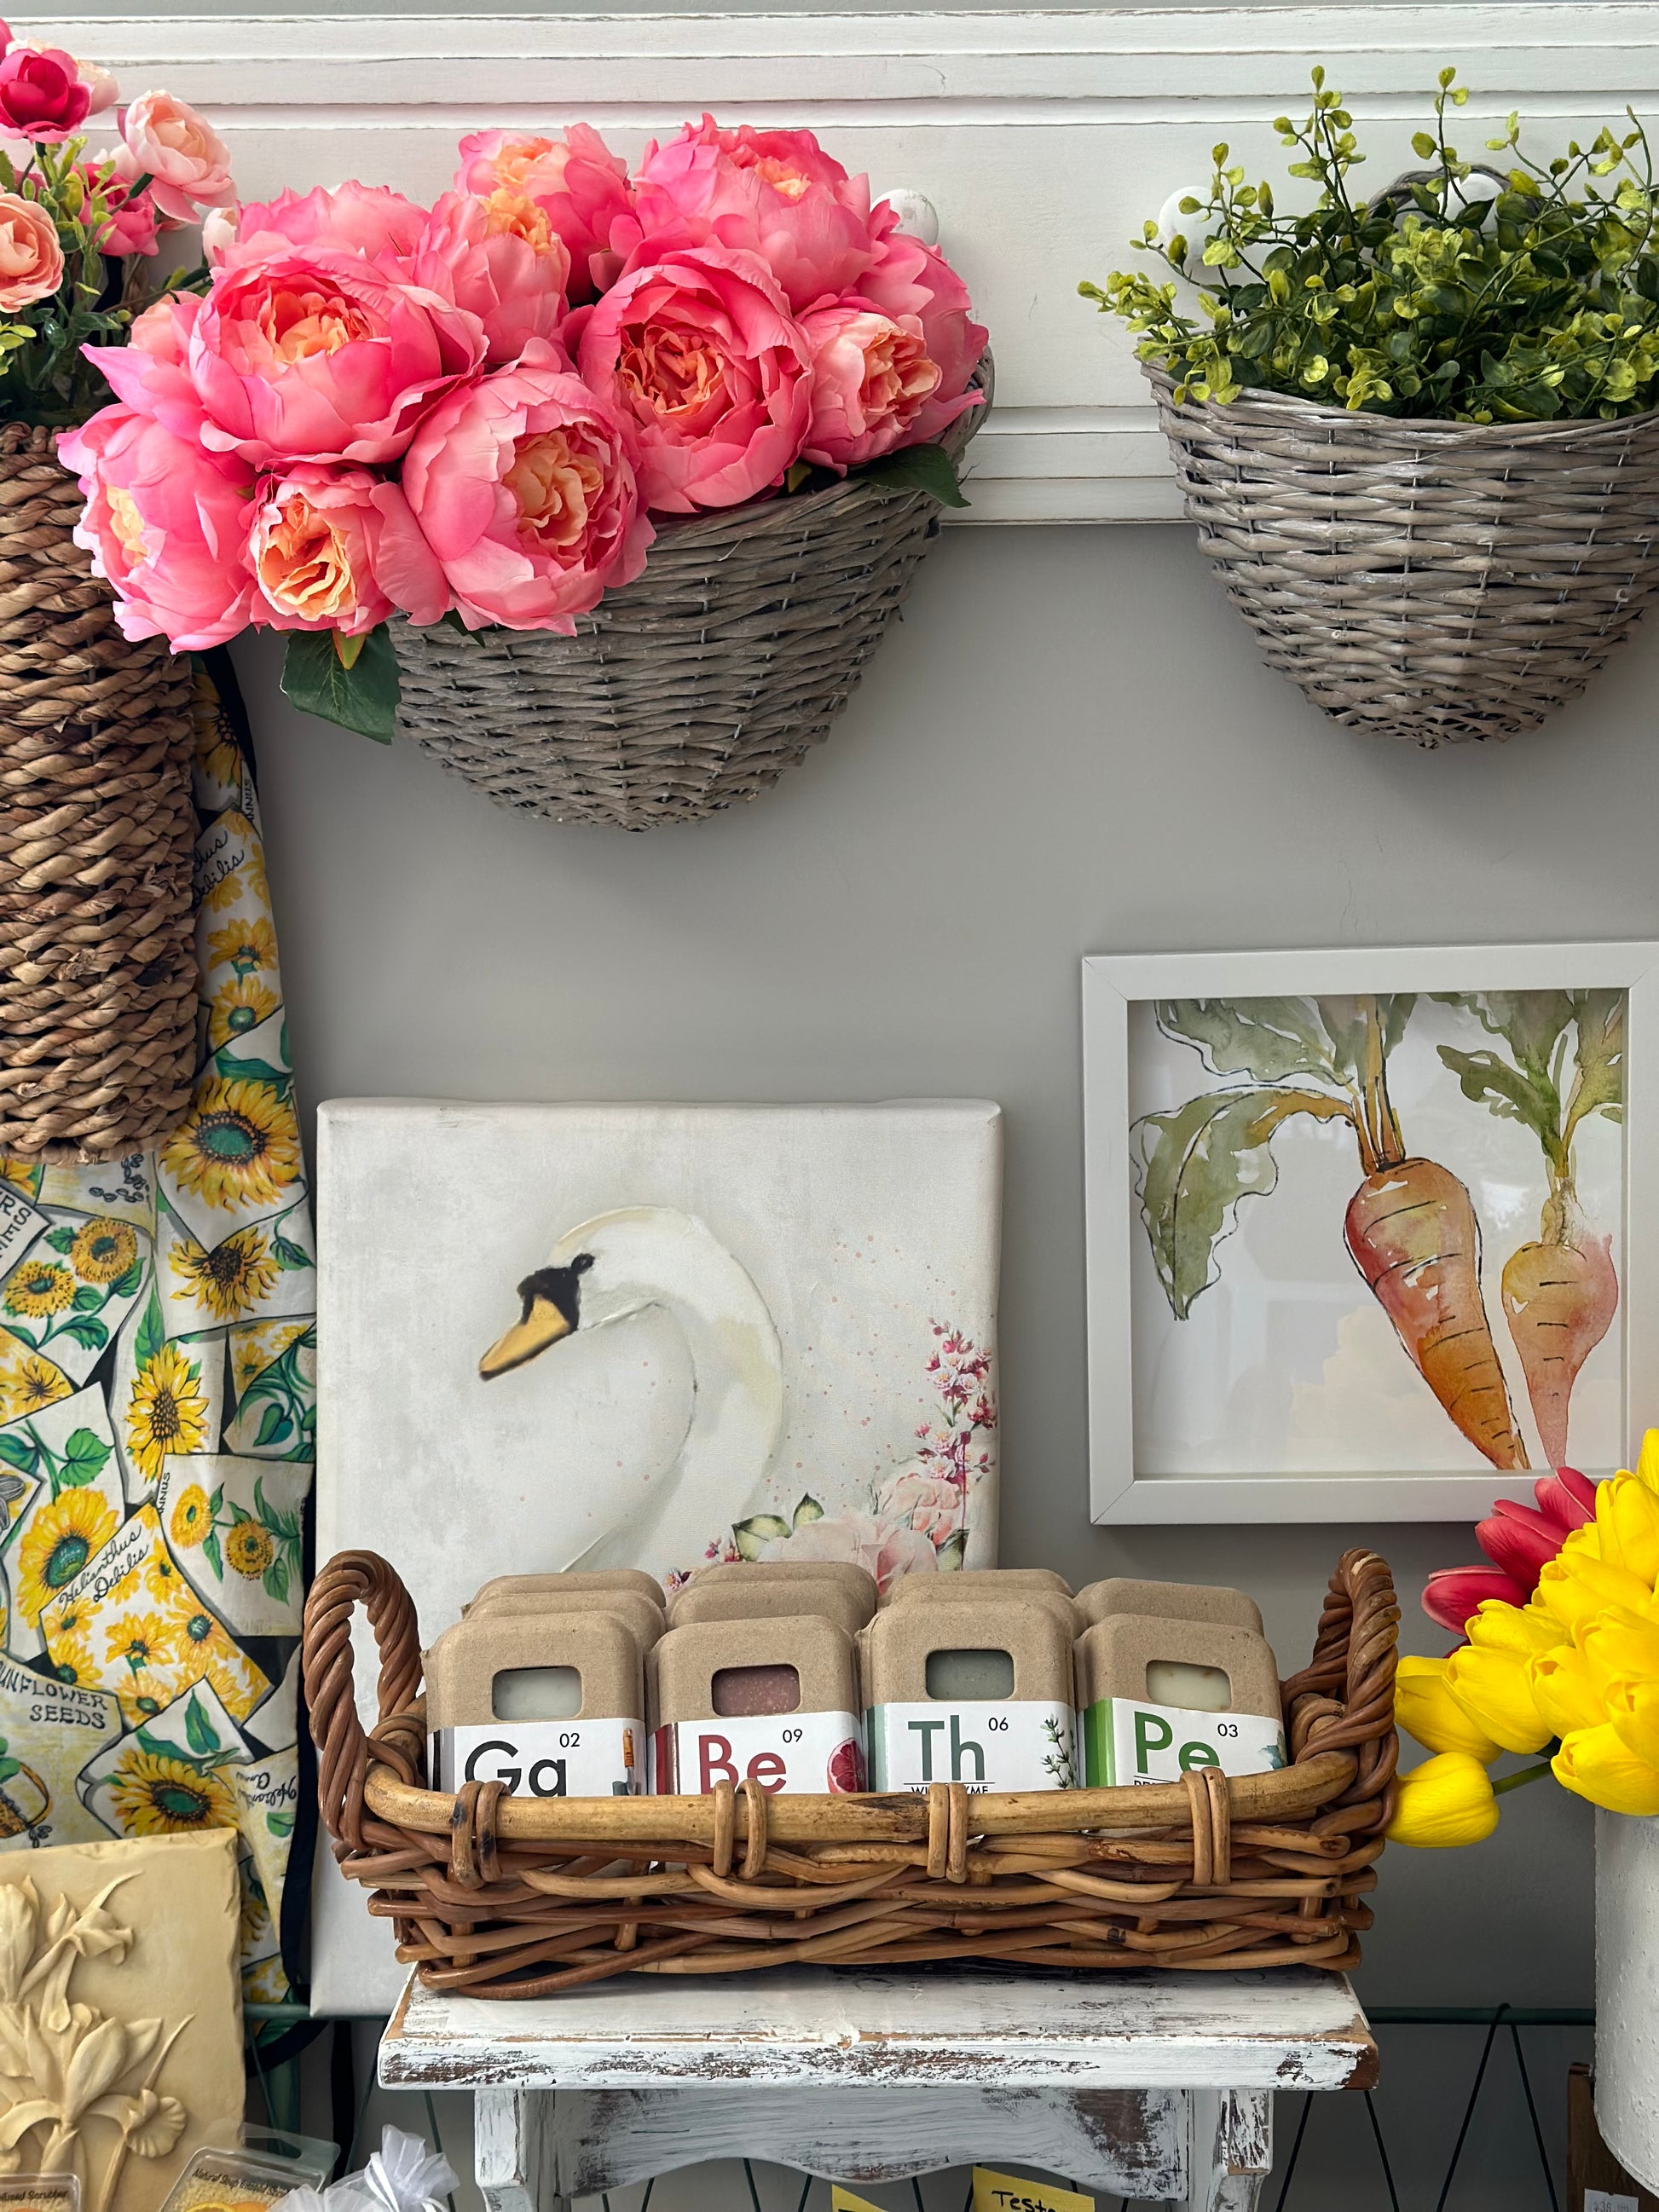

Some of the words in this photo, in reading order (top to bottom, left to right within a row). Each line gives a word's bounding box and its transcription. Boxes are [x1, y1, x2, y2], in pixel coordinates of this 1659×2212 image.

[59, 1525, 142, 1616] Helianthus
[93, 1545, 149, 1603] Debilis
[0, 1660, 108, 1711] UNFLOWER
[29, 1705, 106, 1730] SEEDS
[559, 1732, 581, 1748] 02
[782, 1729, 803, 1743] 09
[988, 1717, 1009, 1731] 06
[1134, 1711, 1221, 1774] Pe
[1217, 1724, 1239, 1738] 03
[465, 1740, 567, 1797] Ga
[698, 1734, 787, 1794] Be
[907, 1714, 986, 1782] Th
